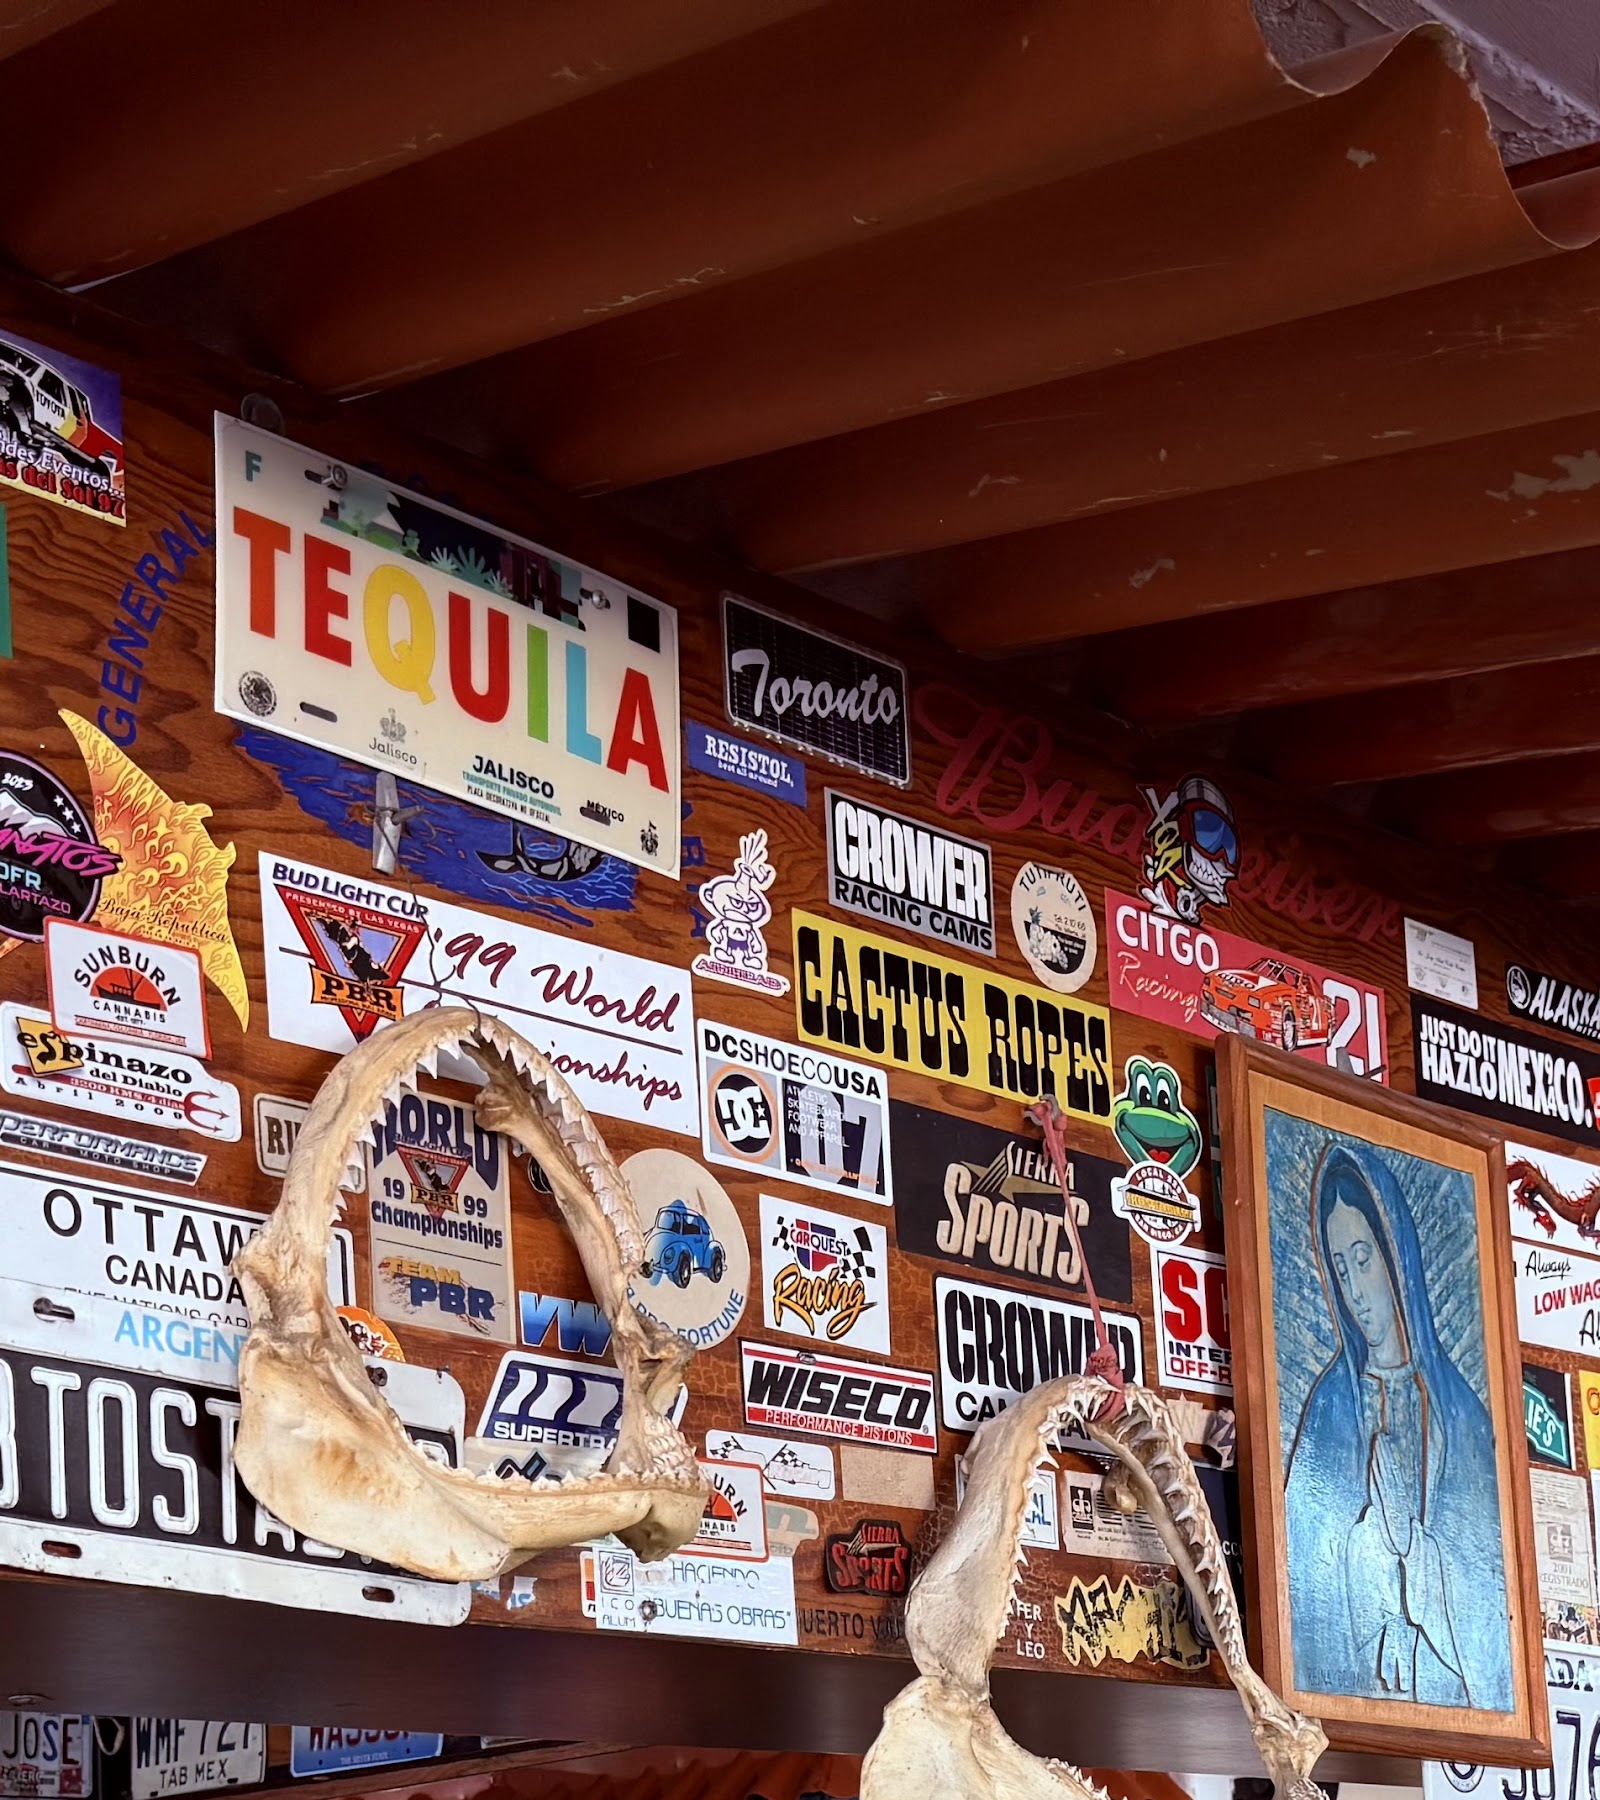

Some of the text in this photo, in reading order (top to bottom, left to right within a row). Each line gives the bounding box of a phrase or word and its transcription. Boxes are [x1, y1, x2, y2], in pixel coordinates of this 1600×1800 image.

[234, 506, 670, 795] TEQUILA
[732, 649, 898, 725] Toronto
[368, 737, 418, 766] Jalisco
[705, 735, 792, 784] RESISTOL
[472, 755, 555, 799] JALISCO
[273, 862, 386, 911] BUD LIGHT
[835, 801, 989, 925] CROWER
[835, 878, 992, 950] RACING CAMS
[1117, 904, 1220, 973] CITGO
[74, 945, 182, 1007] SUNBURN
[530, 962, 681, 1034] World
[93, 1000, 167, 1024] CANNABIS
[797, 926, 1111, 1118] CACTUS ROPES
[1324, 979, 1383, 1082] 21
[1420, 1014, 1498, 1063] JUST DO IT
[121, 1073, 183, 1098] Diablo
[704, 1028, 882, 1099] DCSHOECOUSA
[1421, 1041, 1498, 1100] HAZLO
[15, 1077, 94, 1101] Abril
[43, 1188, 255, 1265] OTTAW
[790, 1224, 849, 1256] CARQUEST
[937, 1163, 1090, 1285] SPORTS
[105, 1256, 246, 1302] CANADA
[383, 1256, 460, 1286] TEAM
[1525, 1245, 1572, 1280] Always
[410, 1279, 495, 1321] PBR
[521, 1290, 613, 1357] VW
[774, 1263, 878, 1340] Racing
[1534, 1291, 1567, 1316] LOW
[747, 1360, 931, 1430] WISECO
[766, 1409, 913, 1446] PERFORMANCE PISTONS
[862, 1523, 900, 1545] SIERRA
[831, 1544, 908, 1592] SPORTS
[160, 1758, 228, 1786] TAB MEX
